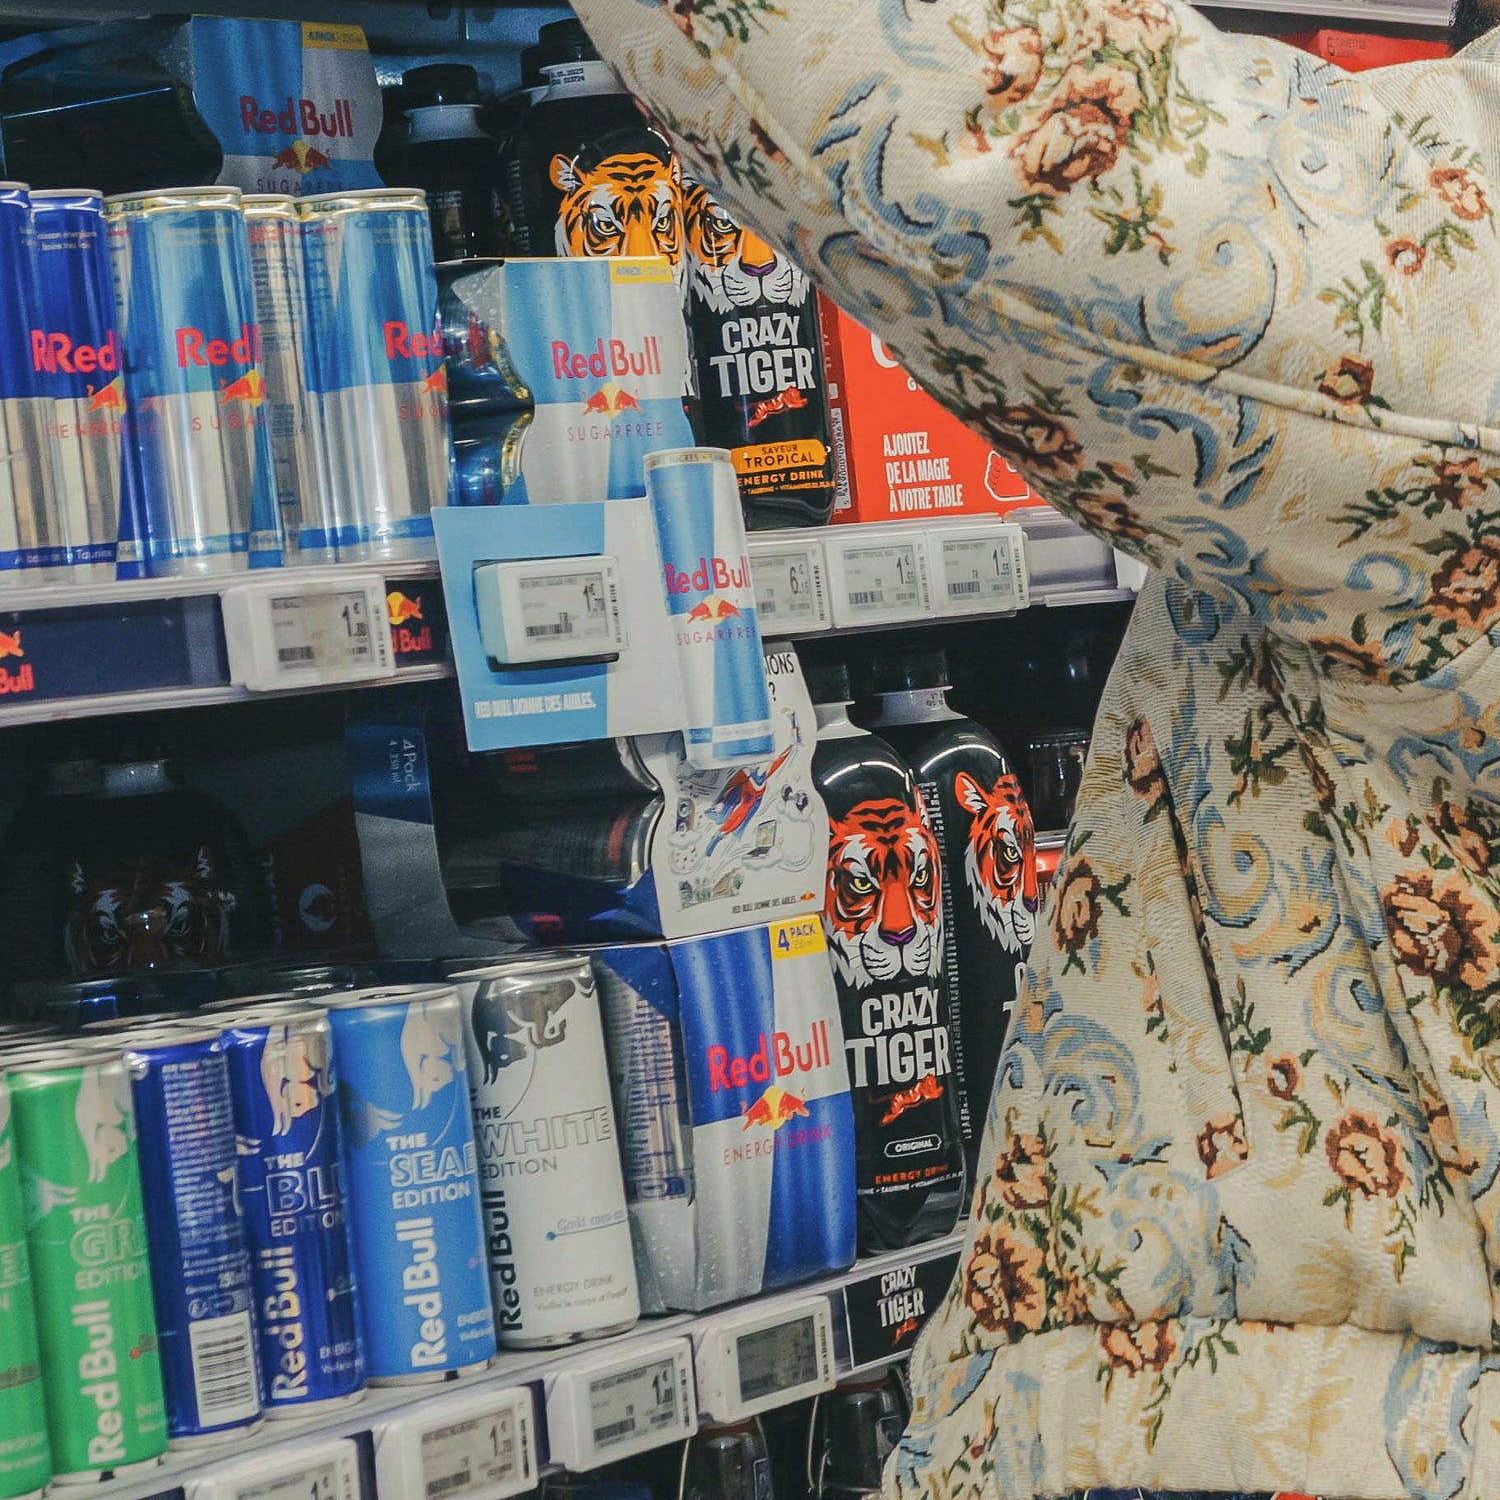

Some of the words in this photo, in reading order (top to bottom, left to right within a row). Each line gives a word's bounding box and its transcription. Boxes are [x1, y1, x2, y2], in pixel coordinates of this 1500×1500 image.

[240, 95, 298, 135] Red
[300, 99, 354, 138] Bull
[175, 324, 252, 368] Red
[383, 320, 443, 360] Red
[722, 312, 801, 354] CRAZY
[551, 339, 606, 380] Red
[610, 336, 662, 377] Bull
[709, 347, 816, 398] TIGER
[567, 421, 664, 442] SUGARFREE
[761, 442, 799, 455] SAVEUR
[883, 431, 930, 457] AJOUTEZ
[738, 472, 786, 488] ENERGY
[788, 470, 825, 483] DRINK
[744, 451, 815, 469] TROPICAL
[887, 462, 897, 484] DE
[898, 460, 914, 483] LA
[915, 457, 951, 481] MAGIE
[899, 487, 931, 512] VOTRE
[931, 483, 964, 509] TABLE
[664, 557, 710, 595] Red
[712, 554, 751, 590] Bull
[400, 627, 431, 654] Bull
[777, 928, 790, 952] 4
[790, 922, 816, 939] PACK
[861, 986, 939, 1037] CRAZY
[707, 1034, 770, 1094] Red
[771, 1019, 831, 1078] Bull
[844, 1025, 952, 1088] TIGER
[474, 1106, 501, 1120] THE
[477, 1105, 612, 1159] WHITE
[264, 1151, 306, 1169] THE
[386, 1132, 428, 1151] THE
[723, 1136, 781, 1166] ENERGY
[894, 1137, 934, 1154] ORIGINAL
[482, 1155, 558, 1180] EDITION
[392, 1180, 471, 1210] EDITION
[482, 1190, 513, 1259] Bull
[395, 1216, 440, 1291] Bull
[259, 1246, 301, 1320] Bull
[499, 1263, 523, 1332] Red
[880, 1265, 916, 1298] CRAZY
[876, 1287, 926, 1329] TIGER
[73, 1300, 117, 1379] Bull
[402, 1291, 448, 1368] Red
[268, 1322, 309, 1400] Red
[81, 1382, 126, 1465] Red
